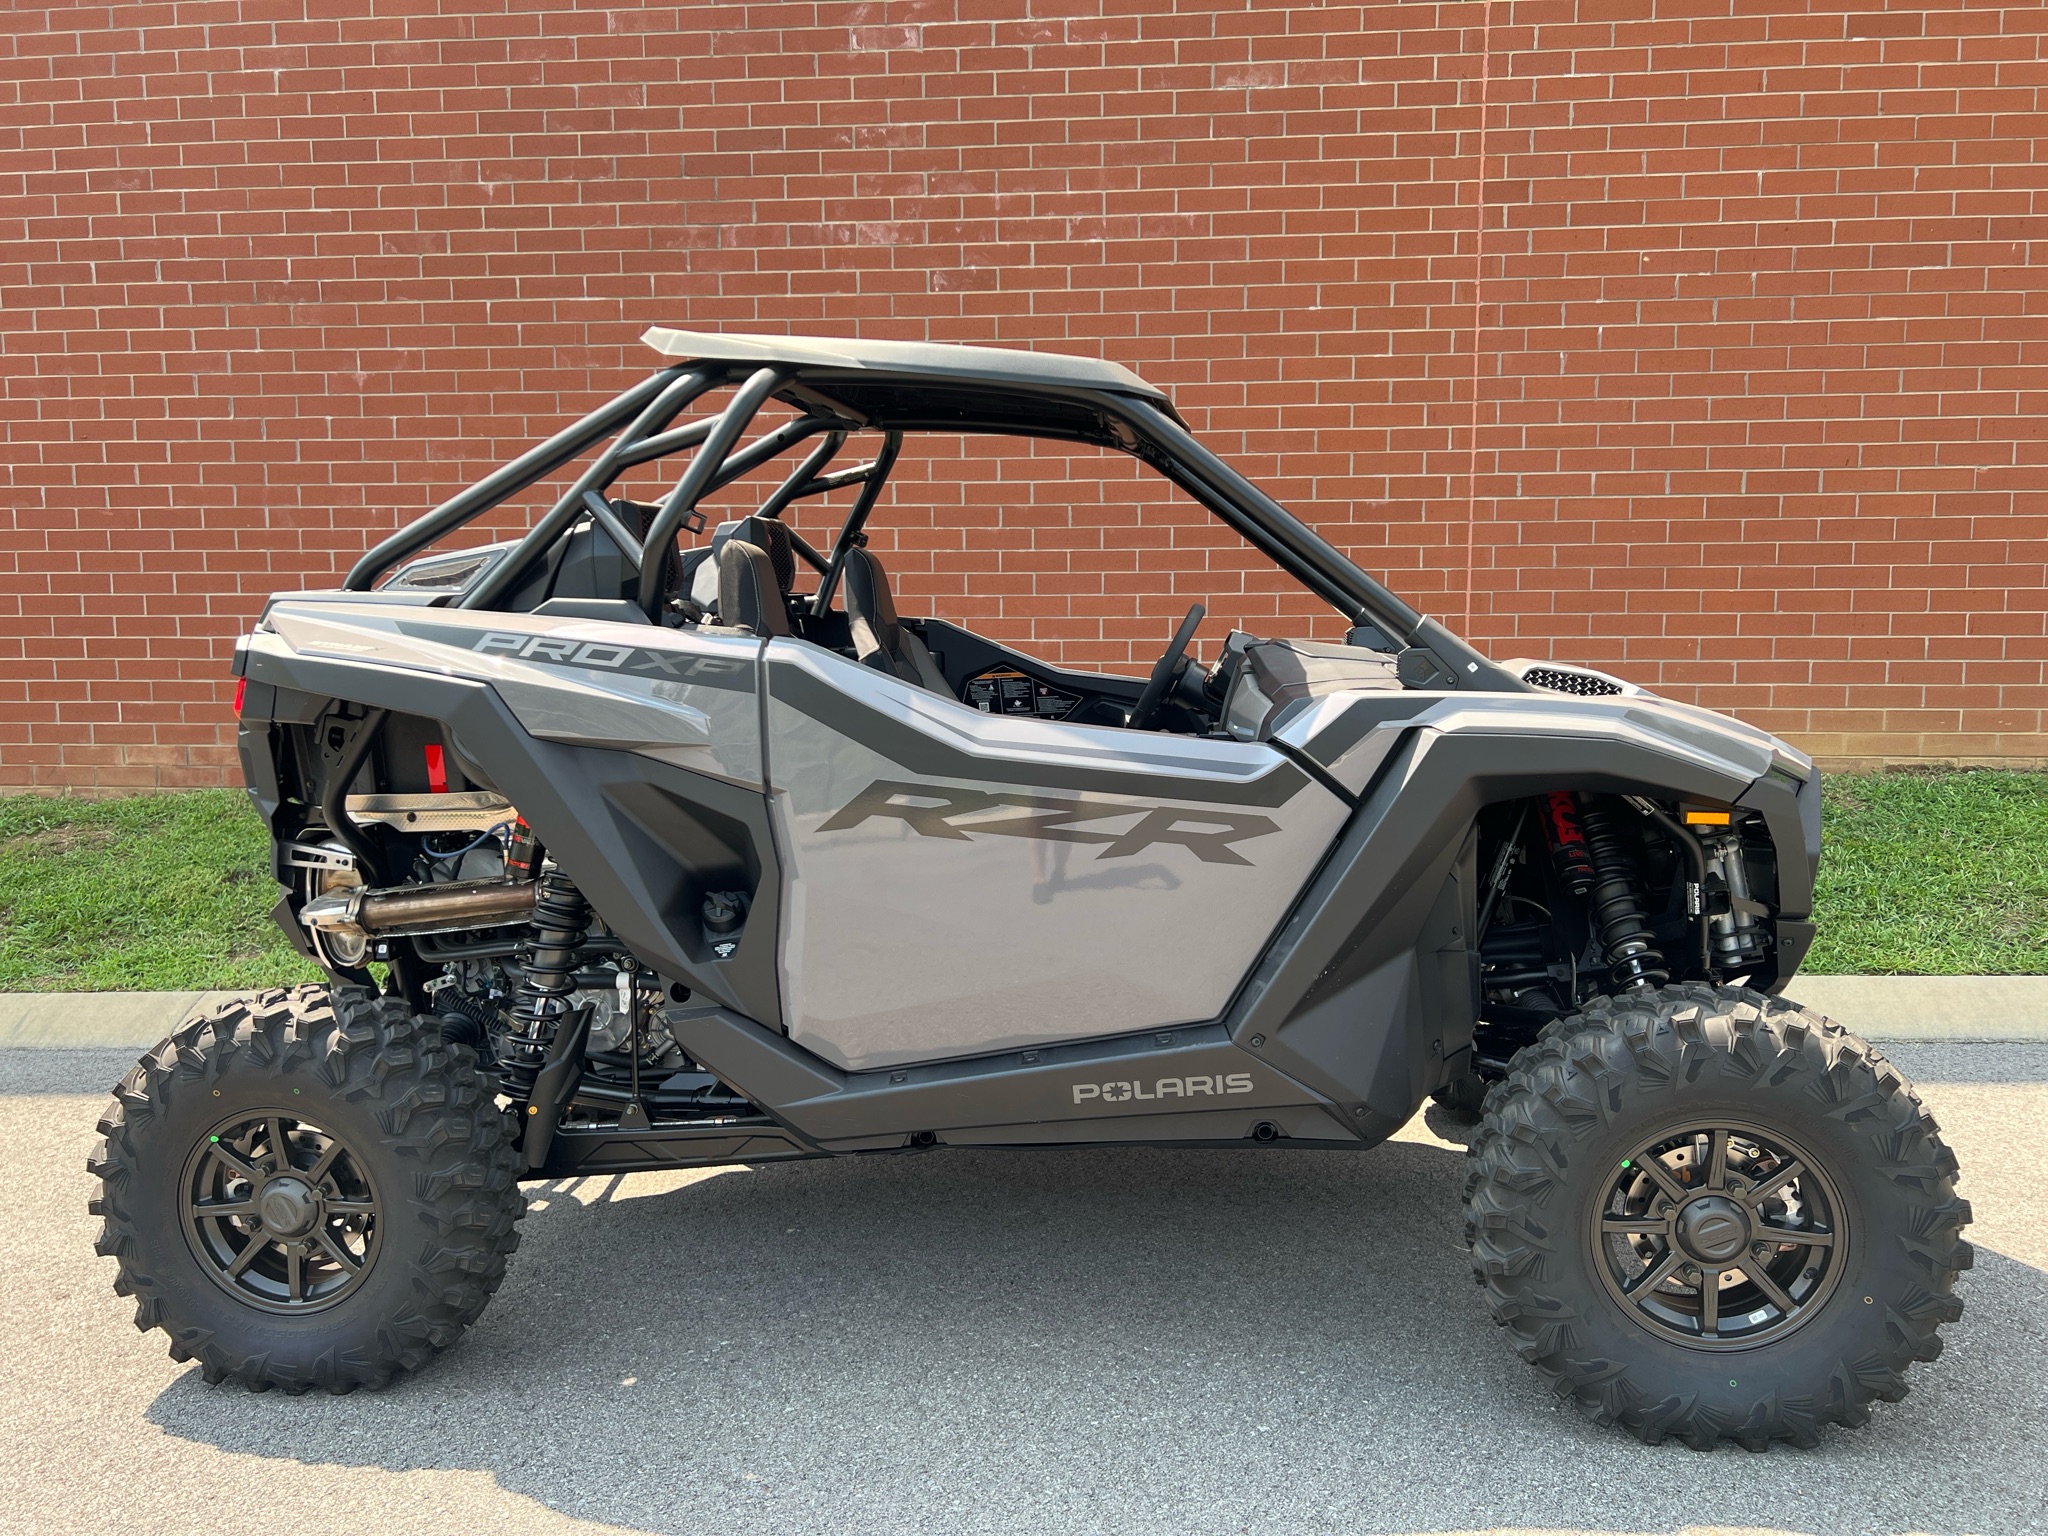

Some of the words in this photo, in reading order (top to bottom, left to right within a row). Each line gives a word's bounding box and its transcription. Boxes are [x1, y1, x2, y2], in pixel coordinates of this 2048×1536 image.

[472, 632, 635, 668] PRO
[631, 651, 747, 677] XP
[814, 779, 1283, 866] RZR
[1693, 883, 1701, 915] POLARIS
[1072, 1073, 1254, 1104] POLARIS
